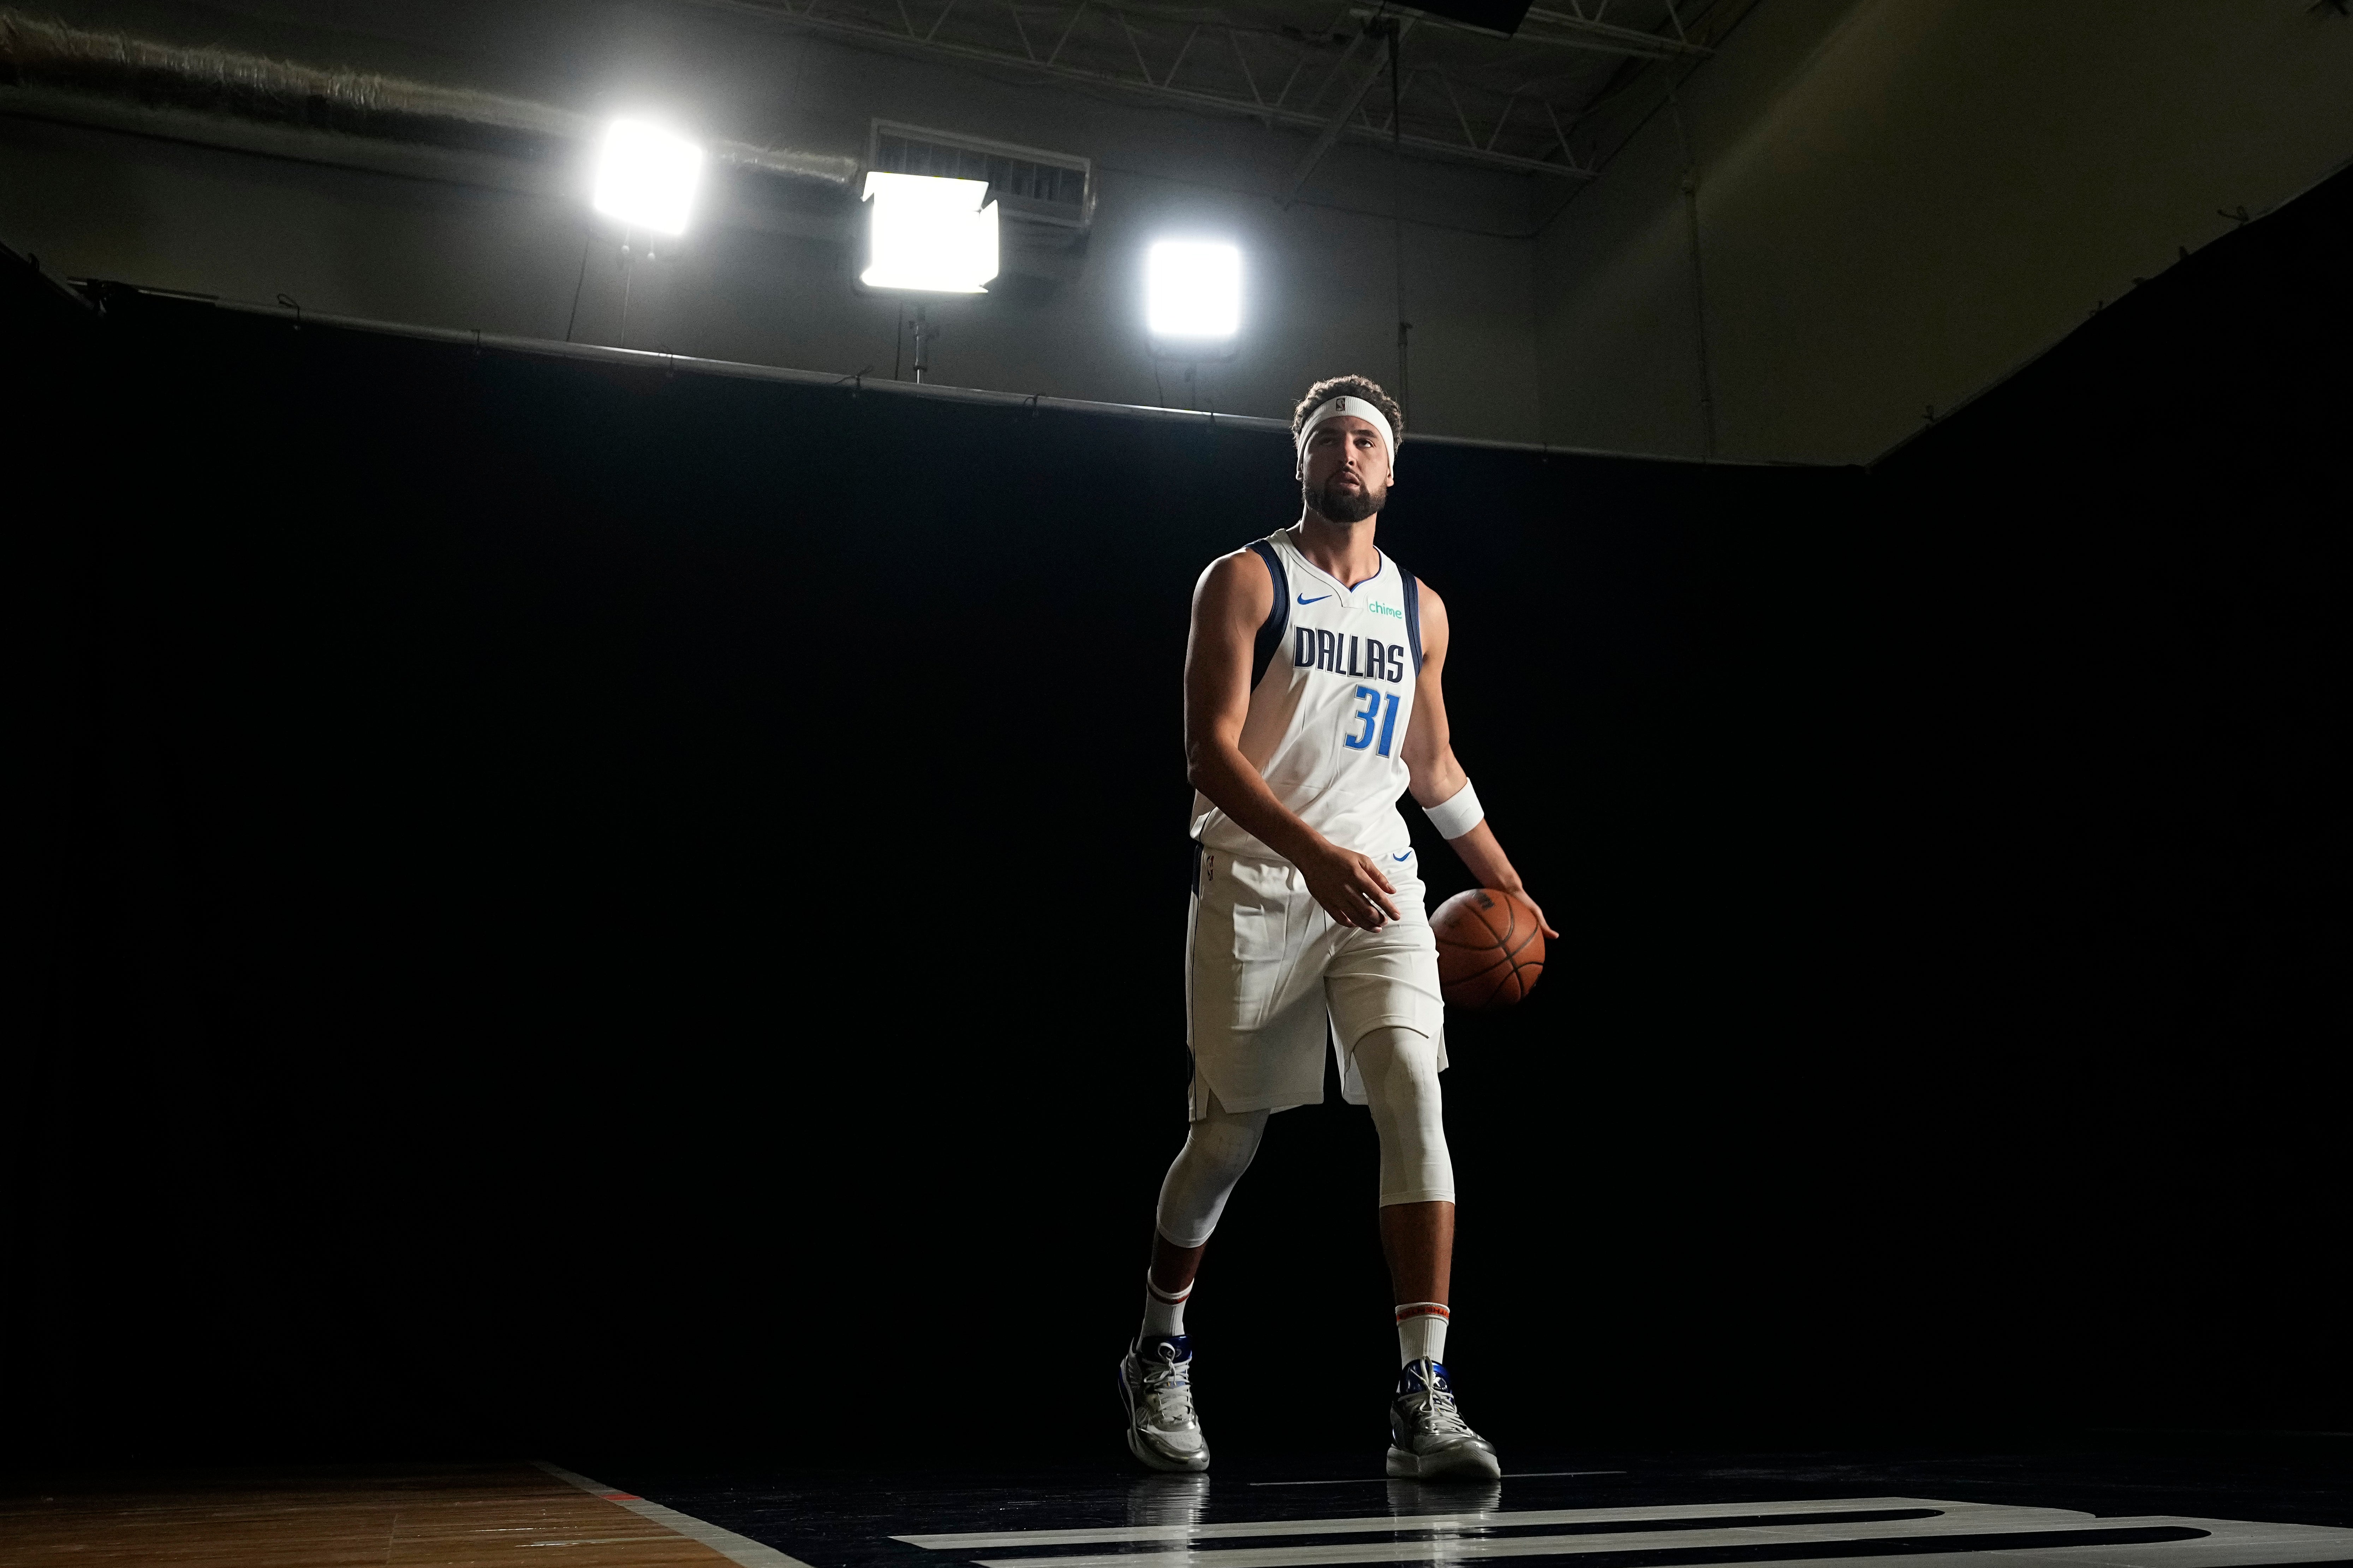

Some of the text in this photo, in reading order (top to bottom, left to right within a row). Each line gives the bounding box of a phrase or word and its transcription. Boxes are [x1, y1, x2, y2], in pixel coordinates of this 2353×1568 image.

[1369, 601, 1402, 619] chime
[1294, 625, 1404, 684] DALLAS
[1343, 684, 1401, 758] 31
